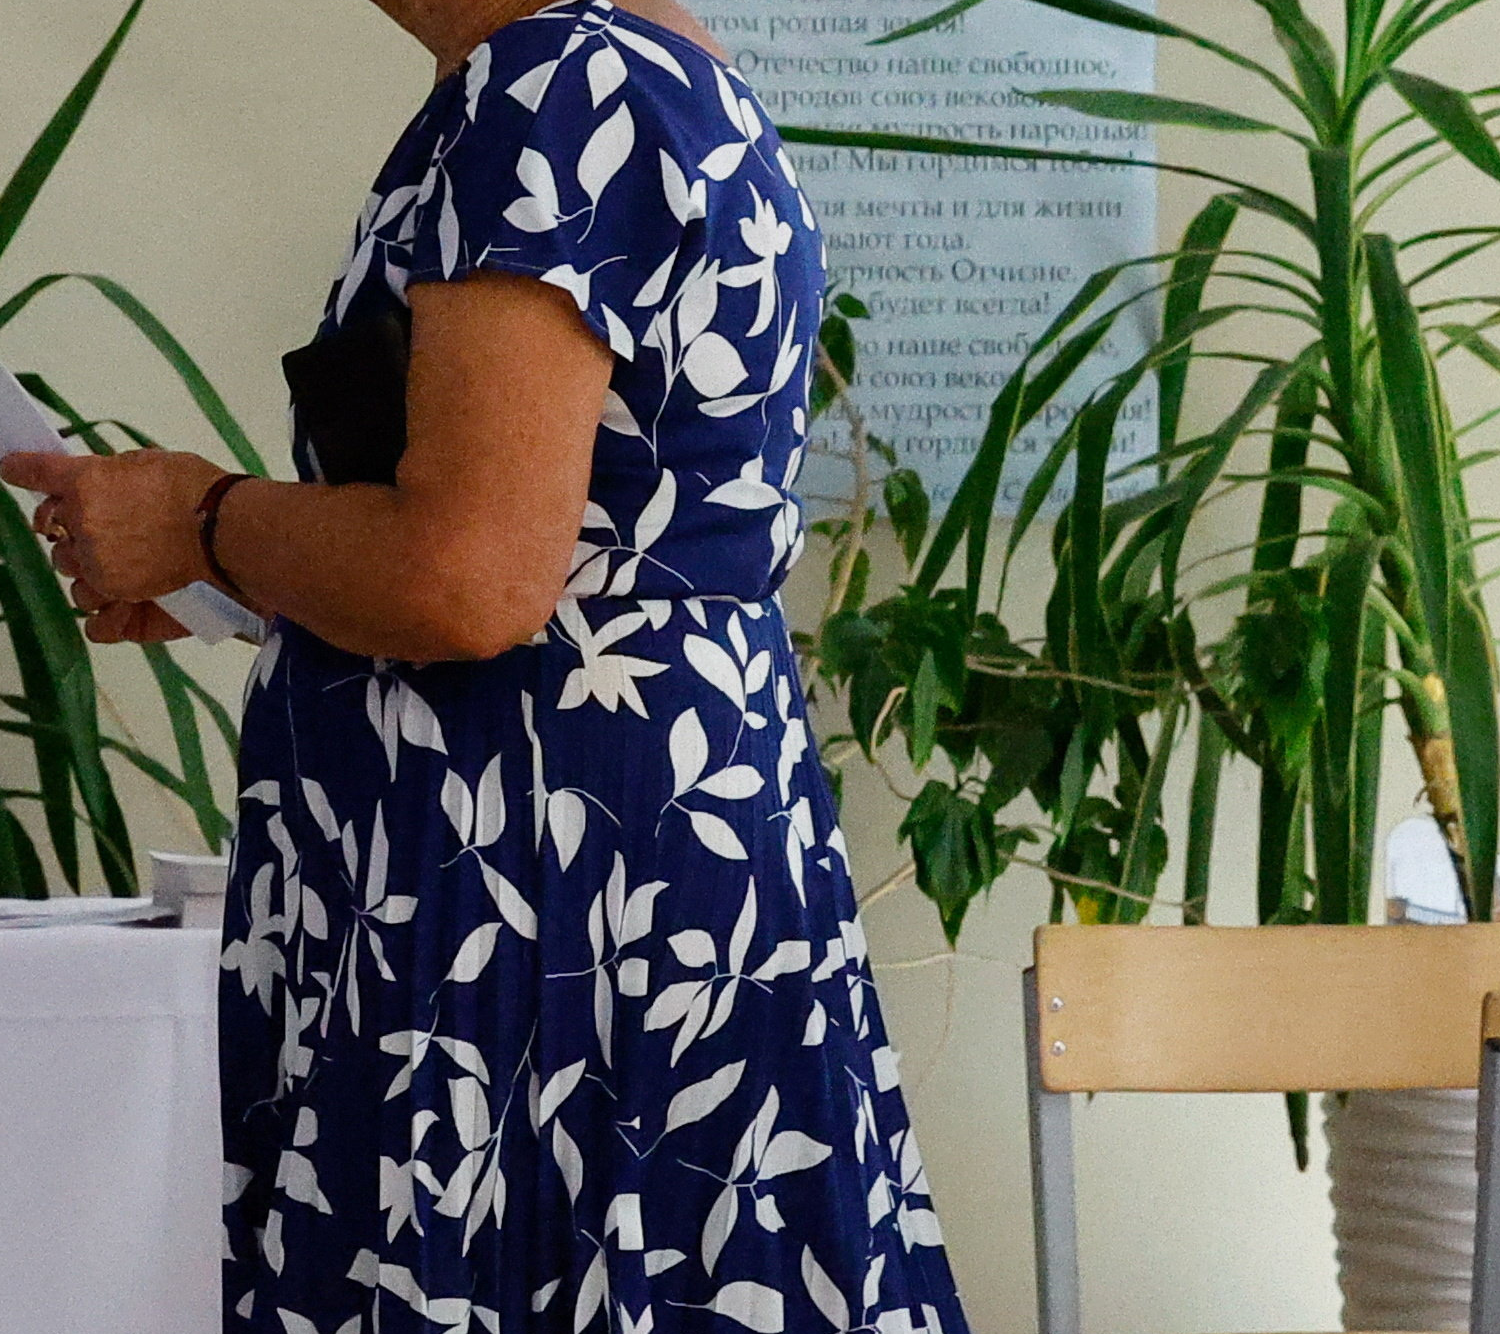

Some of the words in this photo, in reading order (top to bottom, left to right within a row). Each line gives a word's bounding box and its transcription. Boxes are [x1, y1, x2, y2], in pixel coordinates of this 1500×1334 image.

[770, 14, 868, 42] родная
[735, 49, 880, 75] Отечество
[888, 56, 962, 75] наше
[968, 51, 1117, 78] свободное,
[871, 89, 938, 108] союз
[855, 201, 942, 218] мечты
[952, 202, 968, 218] и
[975, 201, 1025, 220] для
[1034, 201, 1122, 219] жизни
[827, 266, 944, 289] ерность
[953, 292, 1051, 316] всегда!
[887, 339, 963, 358] наше
[869, 370, 937, 389] союз
